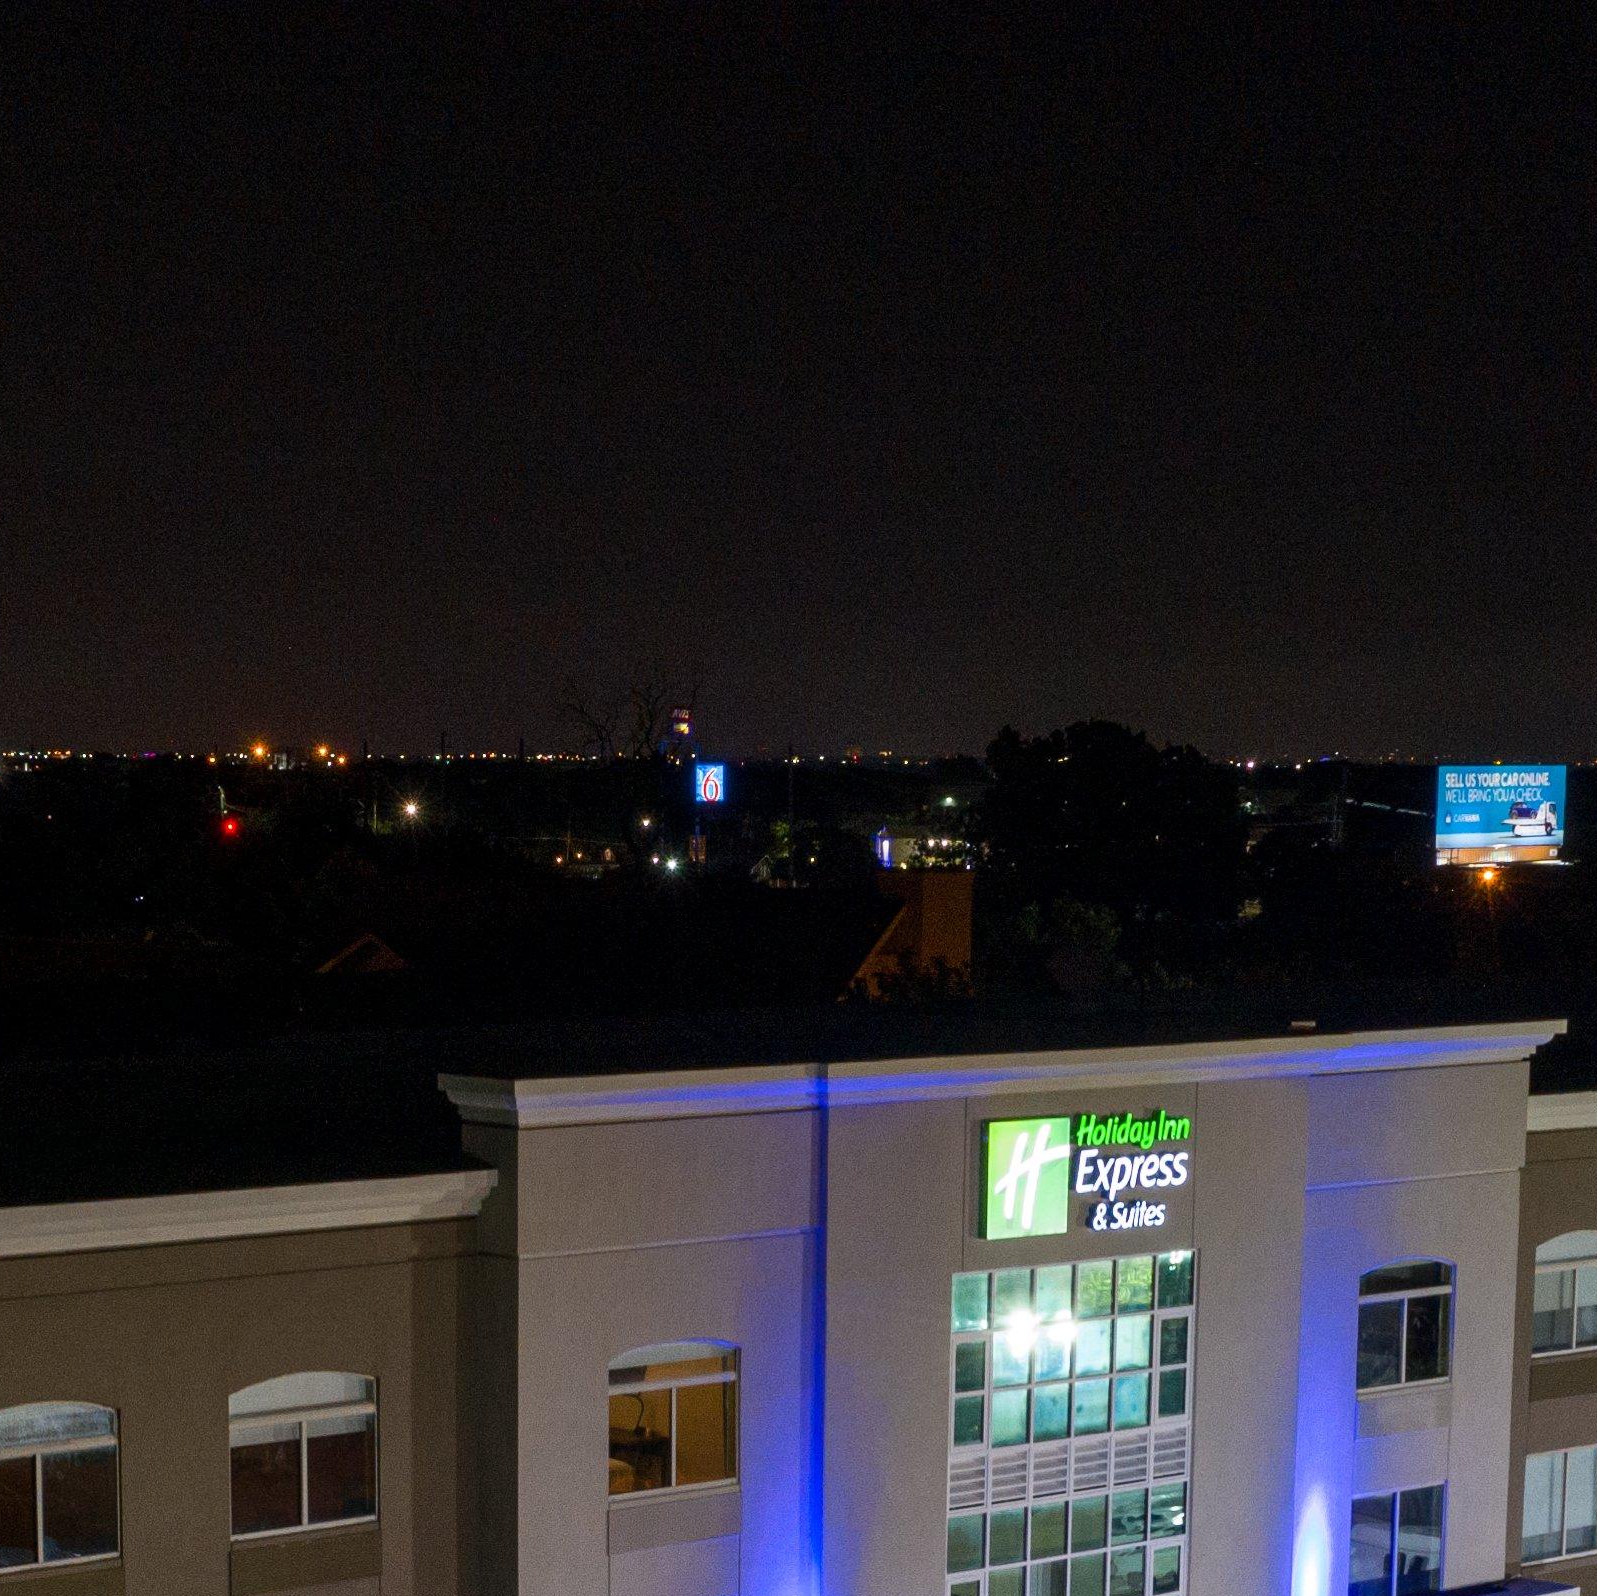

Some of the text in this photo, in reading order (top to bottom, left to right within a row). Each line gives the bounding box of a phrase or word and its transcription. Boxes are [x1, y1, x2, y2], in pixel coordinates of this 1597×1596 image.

[702, 767, 720, 804] 6
[1445, 773, 1463, 788] SELL
[1465, 773, 1476, 788] US
[1477, 773, 1501, 788] YOUR
[1501, 772, 1519, 787] CAR
[1468, 789, 1492, 803] BRING
[1493, 788, 1510, 803] YOU
[1509, 788, 1517, 802] A
[1077, 1109, 1191, 1149] Holiday Inn
[1075, 1148, 1189, 1201] Express
[1092, 1201, 1166, 1231] & Suites
